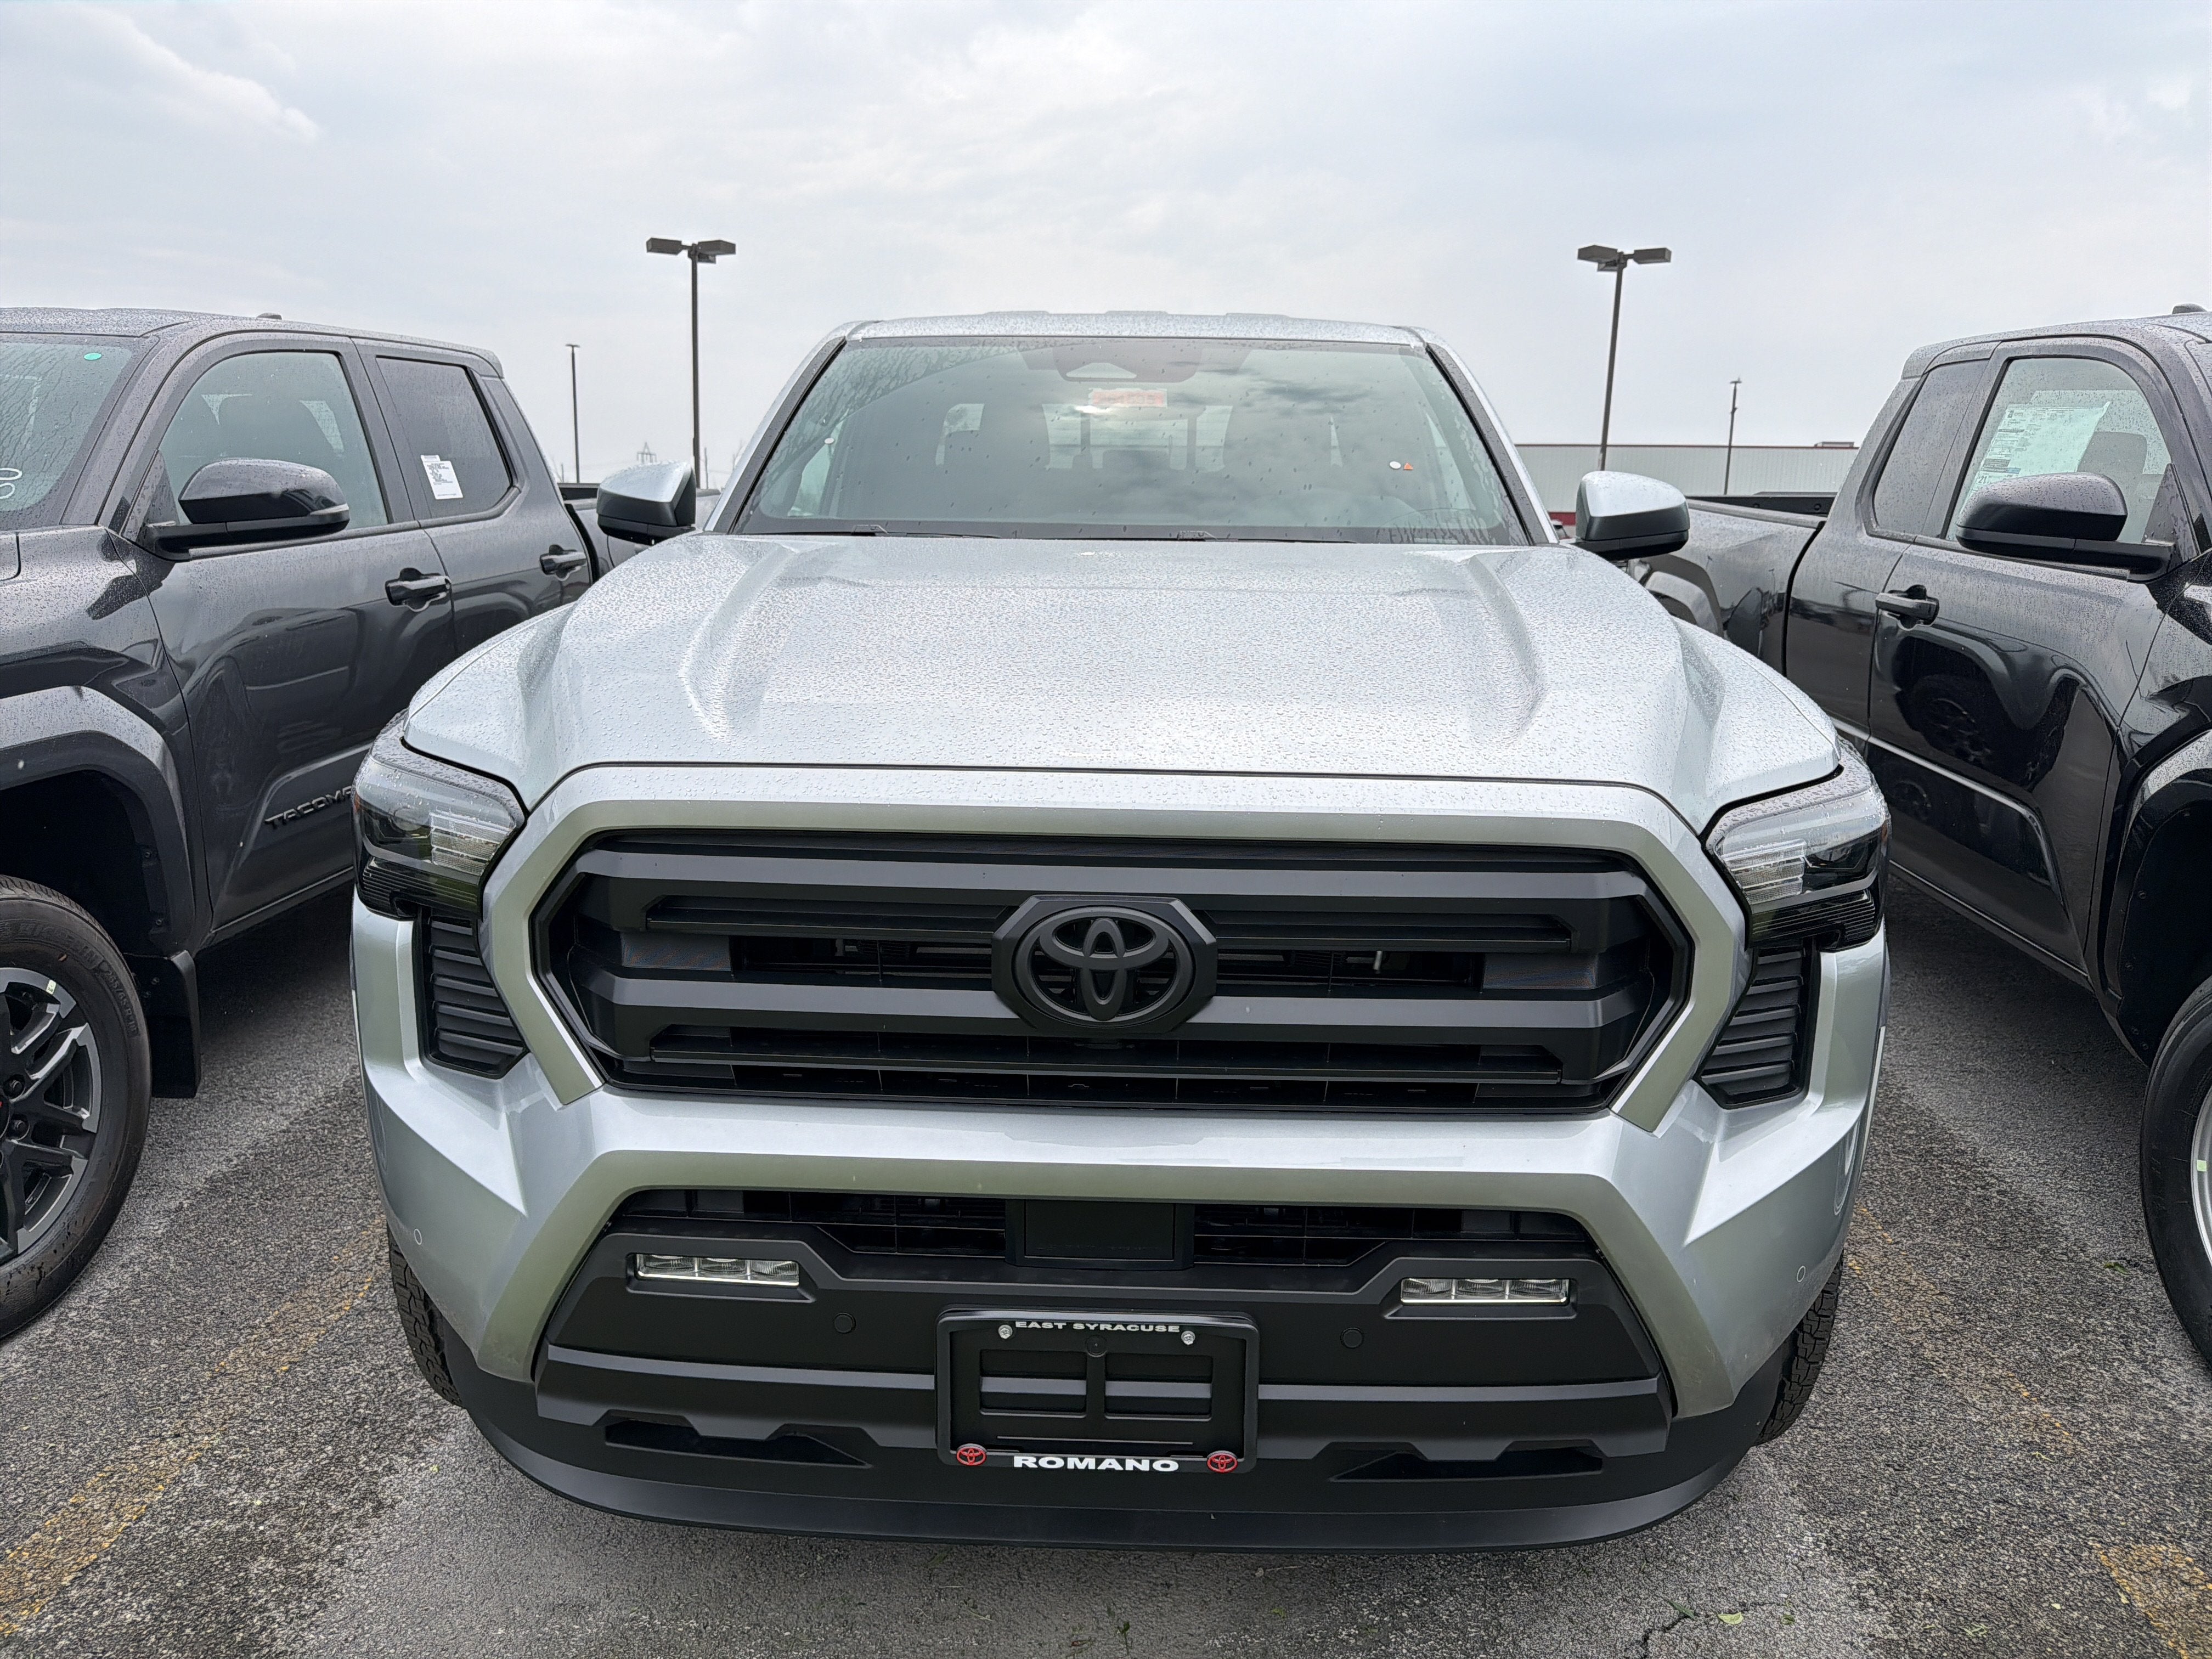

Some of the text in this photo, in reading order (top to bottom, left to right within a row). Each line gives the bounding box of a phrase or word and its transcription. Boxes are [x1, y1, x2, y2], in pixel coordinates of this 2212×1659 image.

[1015, 1321, 1180, 1333] EAST SYRACUSE
[1013, 1455, 1180, 1472] ROMANO
